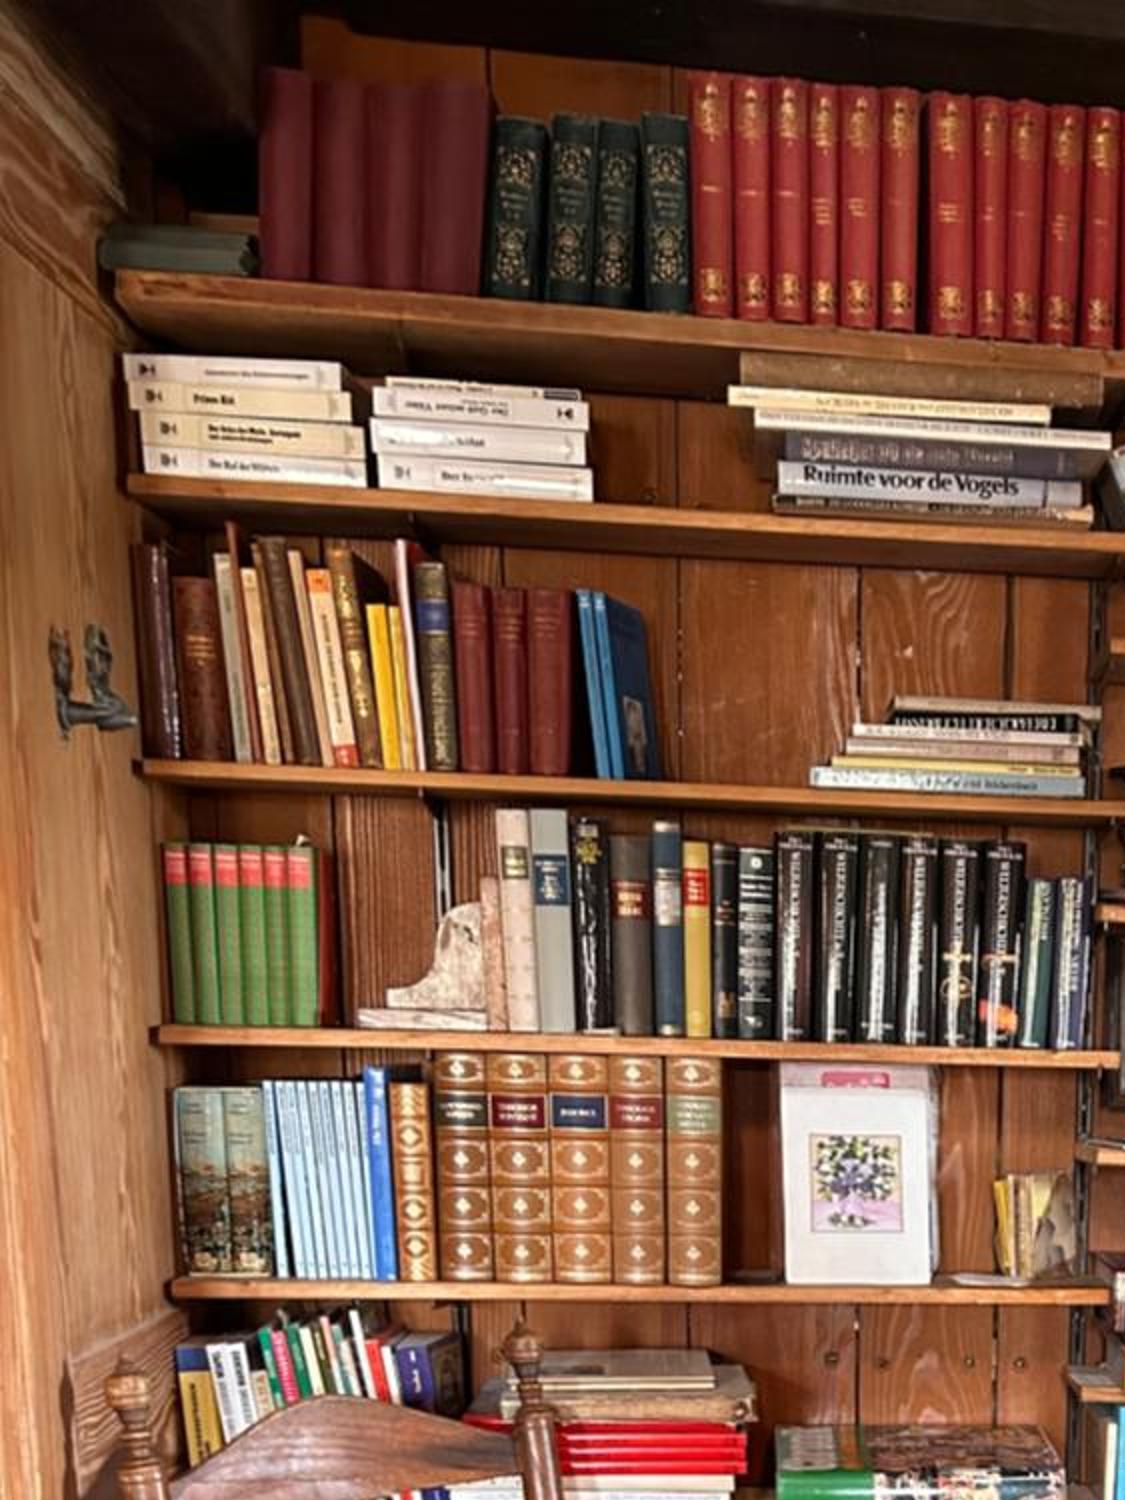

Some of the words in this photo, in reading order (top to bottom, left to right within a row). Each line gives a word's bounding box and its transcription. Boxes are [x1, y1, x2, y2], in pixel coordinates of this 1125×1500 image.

[803, 464, 876, 488] Ruimte
[879, 473, 925, 490] voor
[927, 470, 954, 491] de
[956, 475, 1020, 499] Vogels
